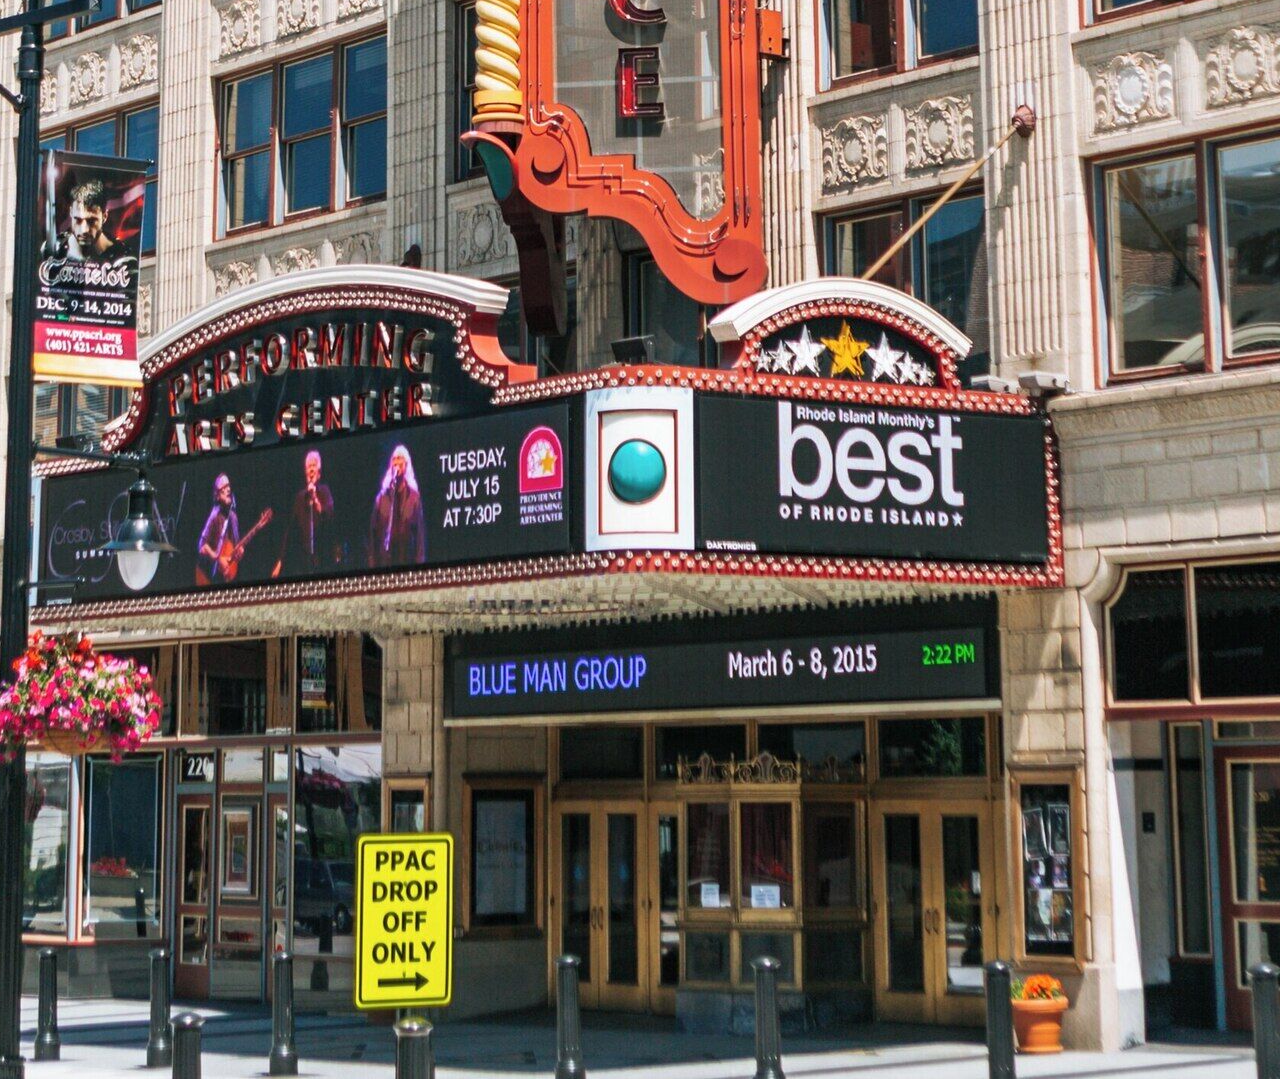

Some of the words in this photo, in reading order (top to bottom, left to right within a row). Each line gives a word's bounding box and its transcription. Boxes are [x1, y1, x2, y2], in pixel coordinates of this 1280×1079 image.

[39, 256, 137, 288] Camelot
[36, 296, 68, 310] DEC.
[103, 302, 132, 316] 2014
[45, 339, 72, 352] (401)
[73, 341, 123, 356] 421-ARTS
[46, 327, 122, 344] www.ppacri.org
[169, 321, 435, 417] PERFORMING
[166, 412, 258, 456] ARTS
[275, 381, 434, 438] CENTER
[796, 406, 836, 422] Rhode
[839, 409, 876, 425] Island
[878, 412, 935, 430] Monthly's
[439, 446, 507, 474] TUESDAY,
[778, 401, 964, 506] best
[446, 478, 480, 501] JULY
[484, 475, 500, 496] 15
[520, 491, 562, 503] PROVIDENCE
[443, 508, 463, 528] AT
[464, 503, 502, 526] 7:30P
[537, 512, 563, 523] CENTER
[779, 503, 803, 520] OF
[810, 504, 874, 523] RHODE
[880, 508, 949, 527] ISLAND
[728, 650, 777, 678] March
[782, 649, 794, 675] 6
[810, 647, 828, 678] 8,
[832, 644, 877, 673] 2015
[922, 645, 952, 665] 2:22
[955, 643, 975, 664] PM
[470, 664, 517, 695] BLUE
[523, 660, 567, 692] MAN
[574, 655, 647, 690] GROUP
[375, 850, 436, 872] PPAC
[372, 880, 438, 902] DROP
[383, 911, 427, 933] OFF
[372, 941, 436, 964] ONLY
